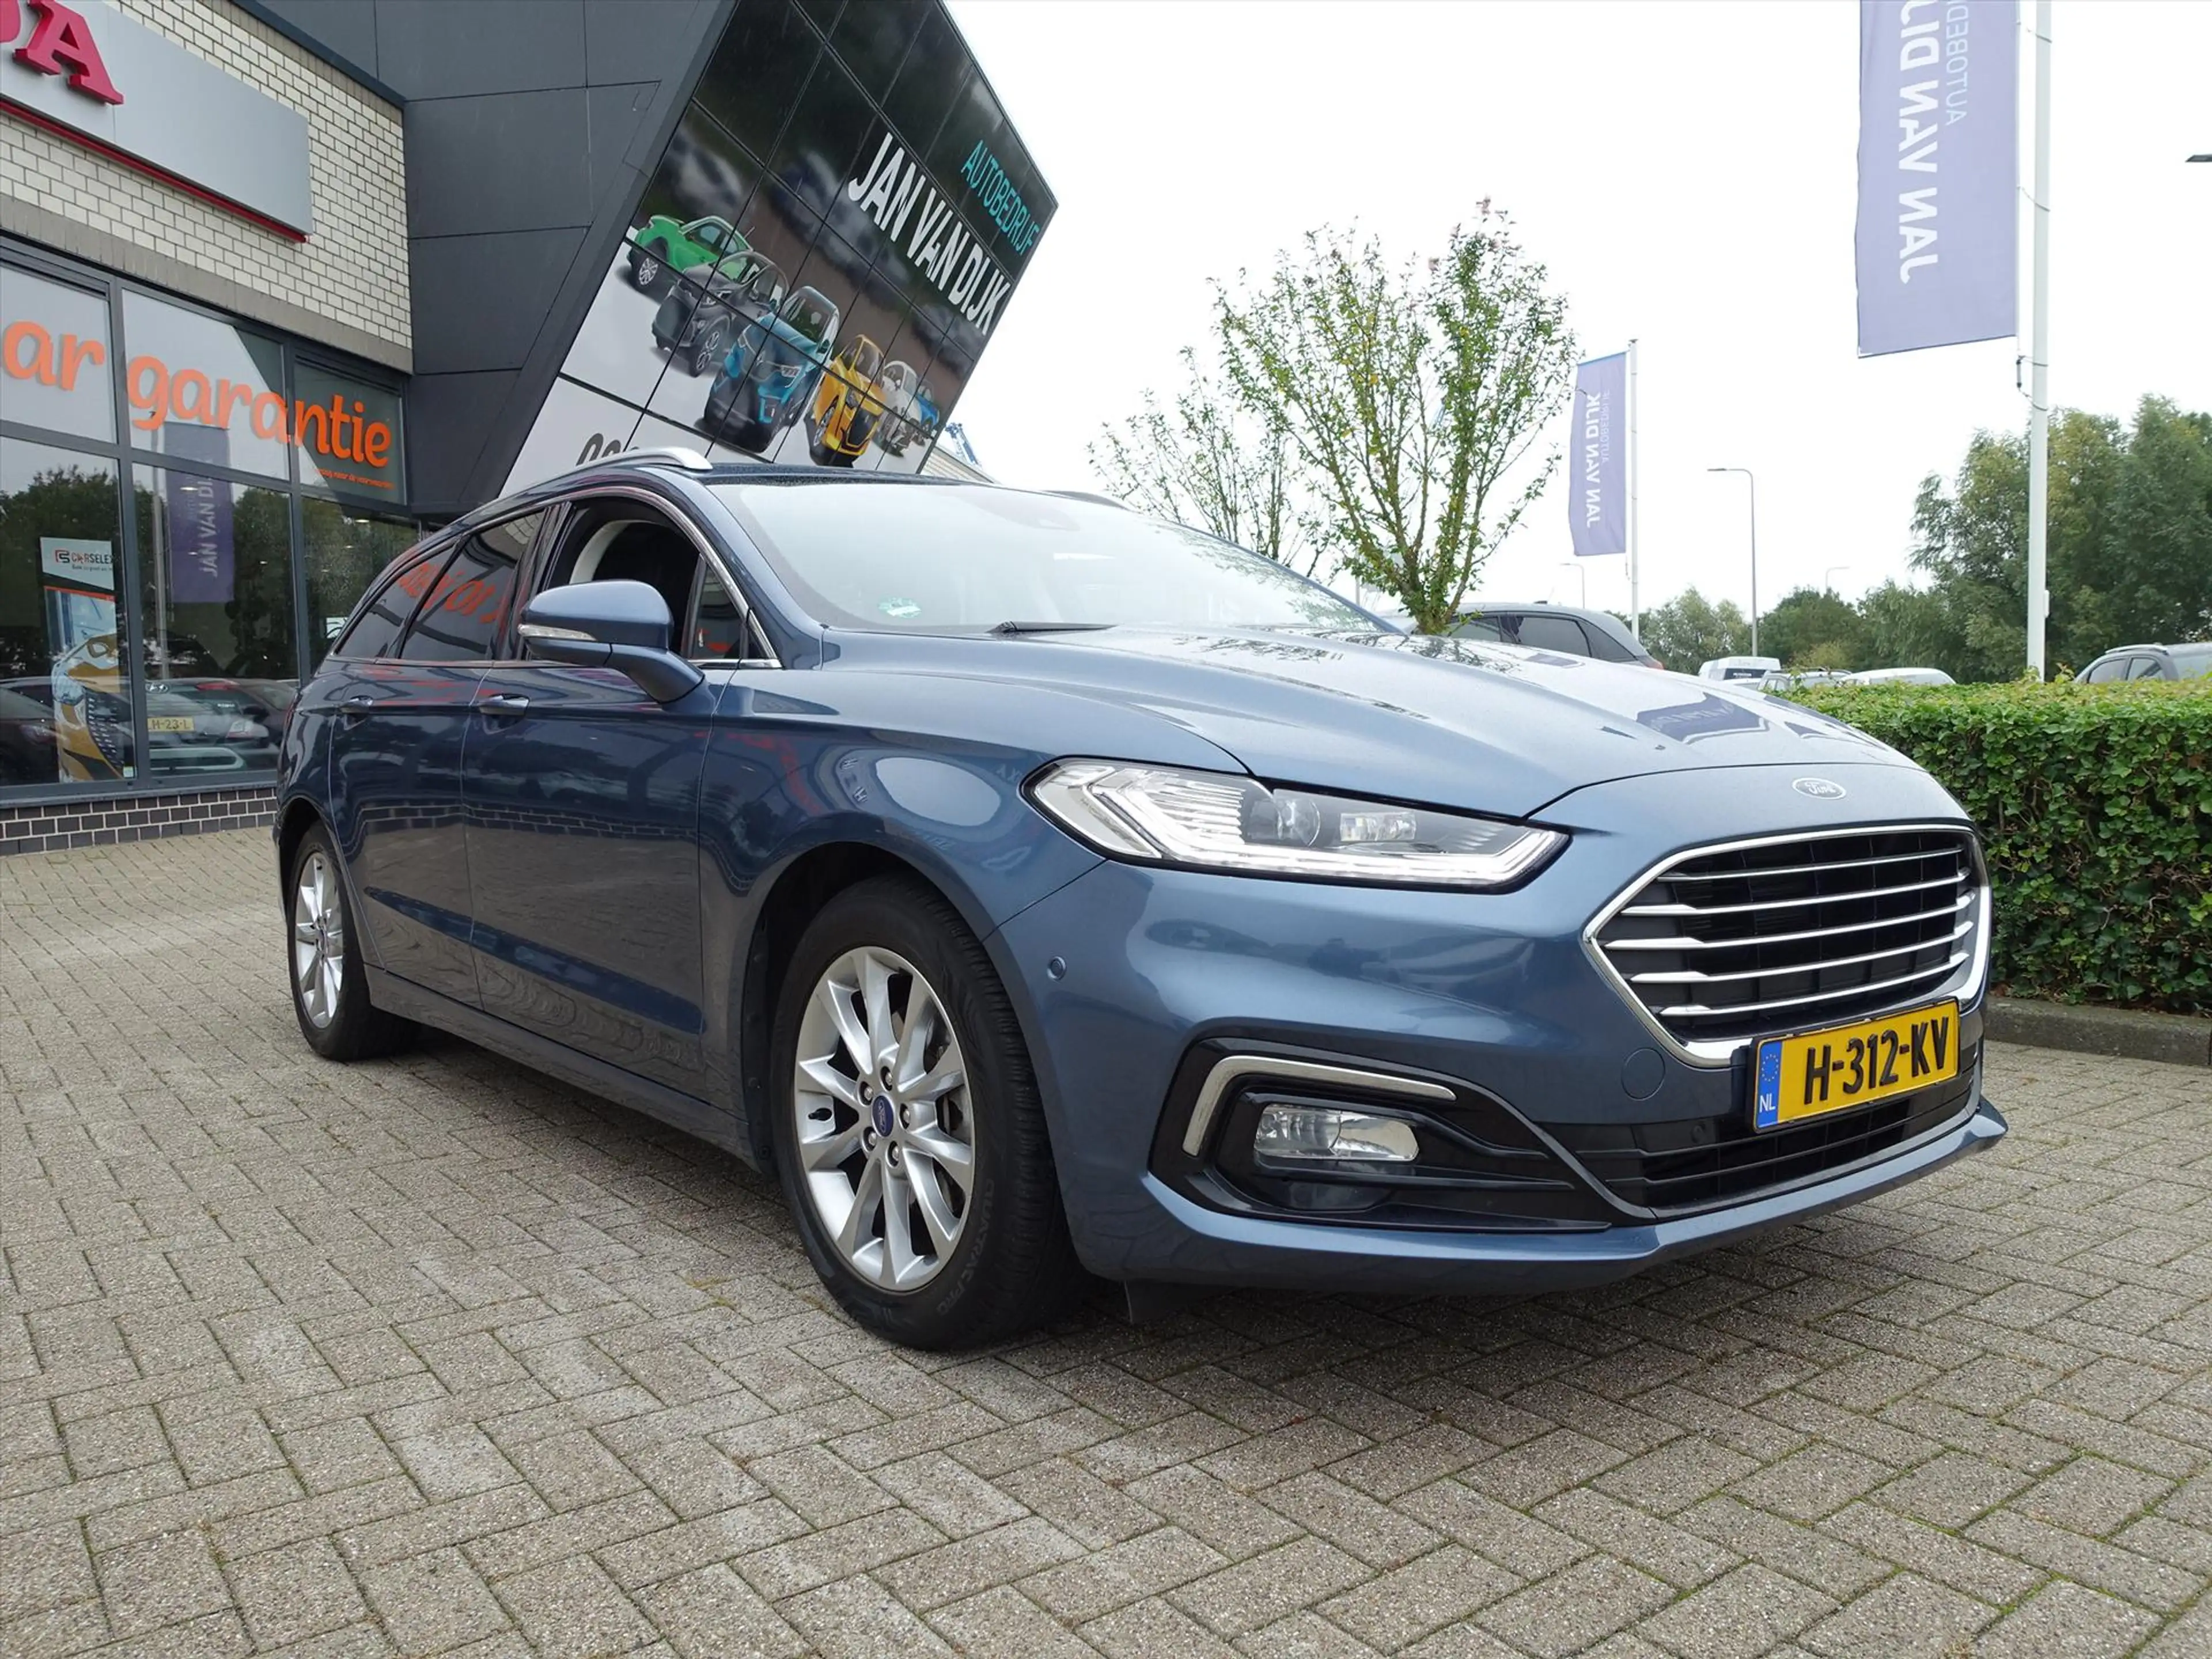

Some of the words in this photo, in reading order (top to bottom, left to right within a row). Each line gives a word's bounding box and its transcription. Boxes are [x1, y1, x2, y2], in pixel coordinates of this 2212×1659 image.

[0, 0, 124, 105] A
[848, 132, 926, 242] JAN
[907, 187, 970, 291] VAN
[948, 243, 1011, 336] DIJK
[961, 140, 1039, 255] AUTOBEDRIJF
[127, 355, 392, 468] garantie
[198, 478, 214, 498] DI
[198, 503, 217, 538] VAN
[199, 543, 218, 578] JAN
[1759, 1093, 1776, 1113] NL
[1804, 1017, 1949, 1105] H-312-KV
